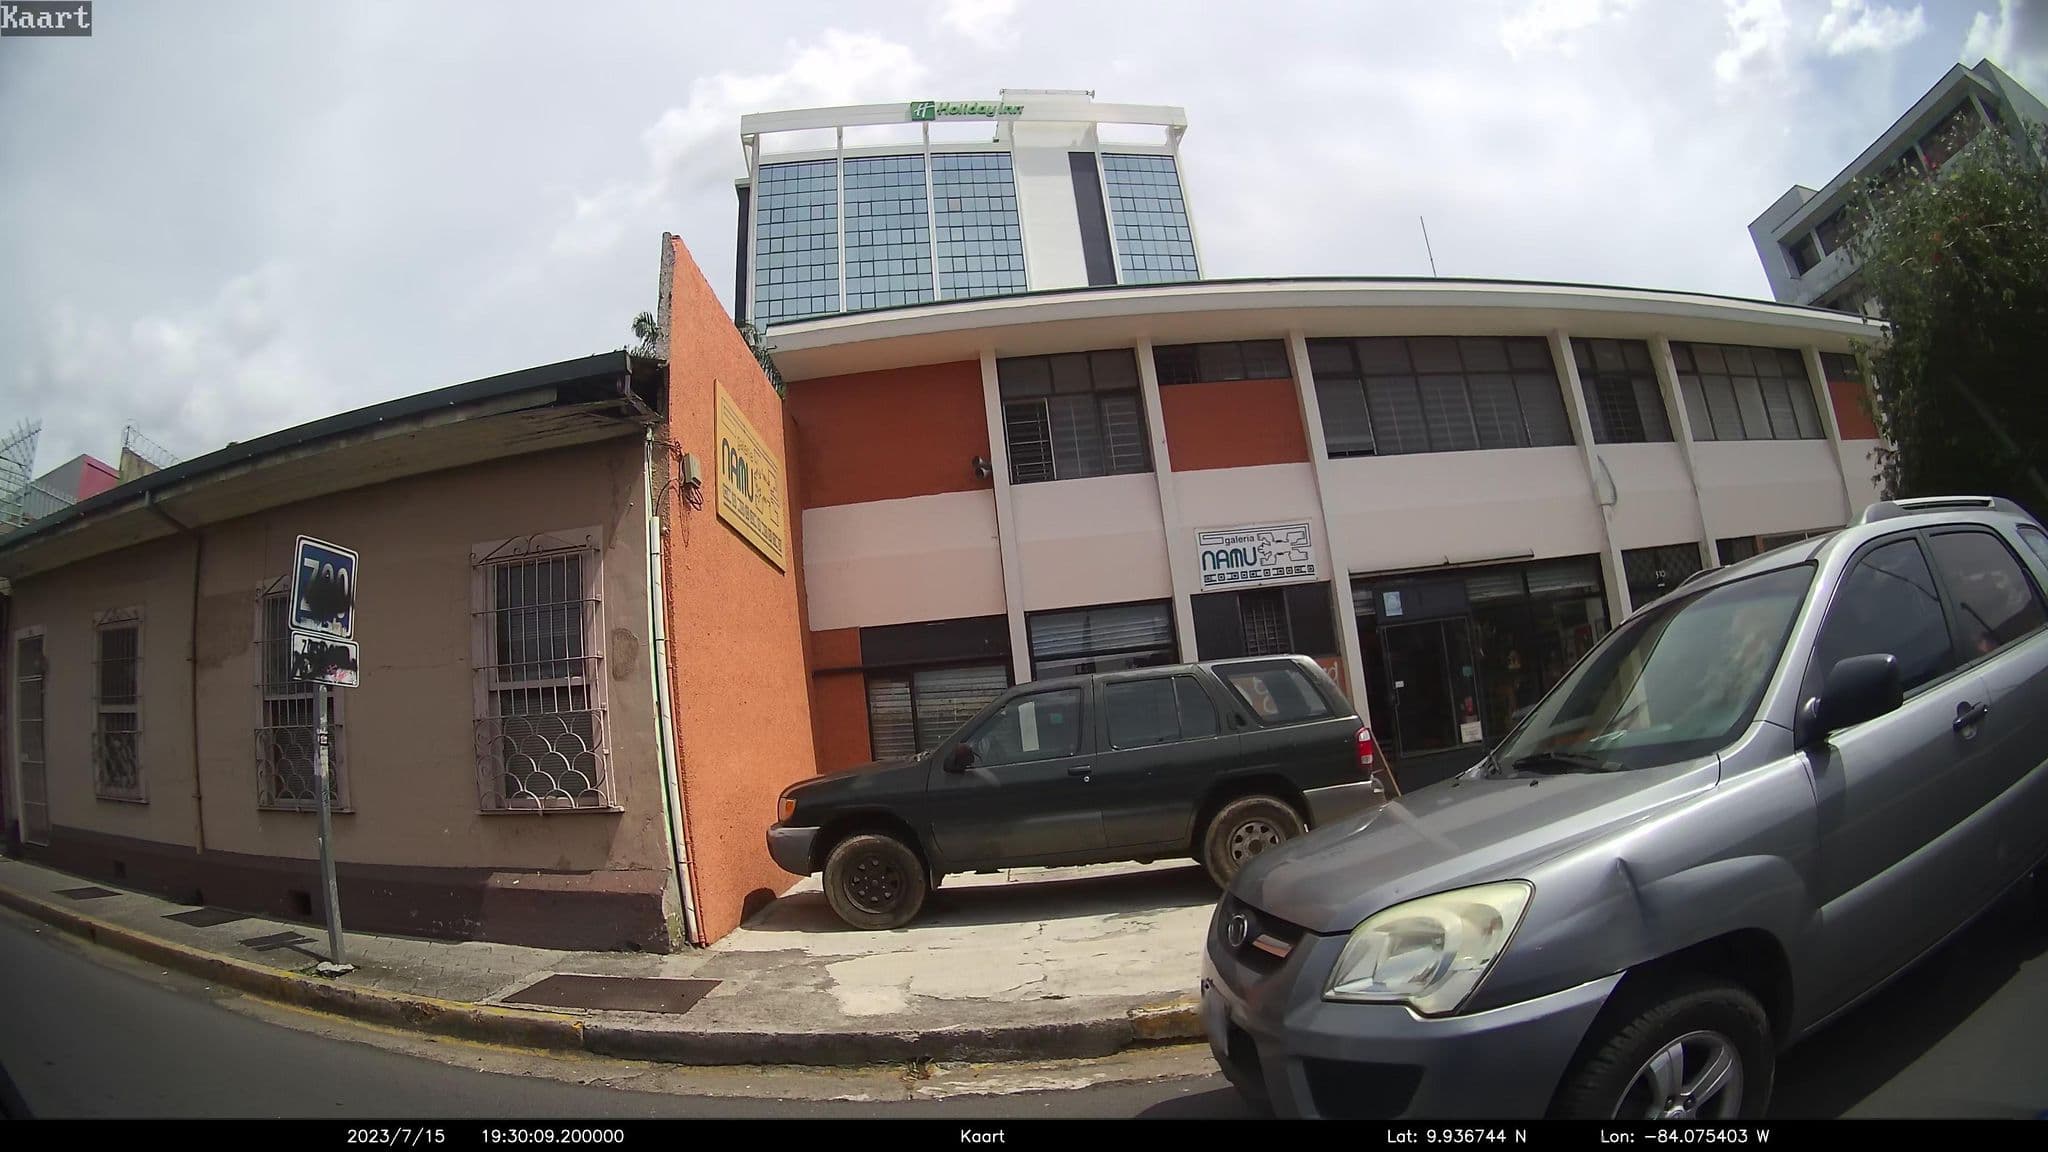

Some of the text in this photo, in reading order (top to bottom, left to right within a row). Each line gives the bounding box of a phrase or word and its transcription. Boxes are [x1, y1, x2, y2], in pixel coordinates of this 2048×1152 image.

[936, 102, 1025, 117] Holiday Inn
[722, 437, 754, 503] NAMU
[1224, 535, 1255, 547] galeria
[1202, 546, 1258, 571] NAMU
